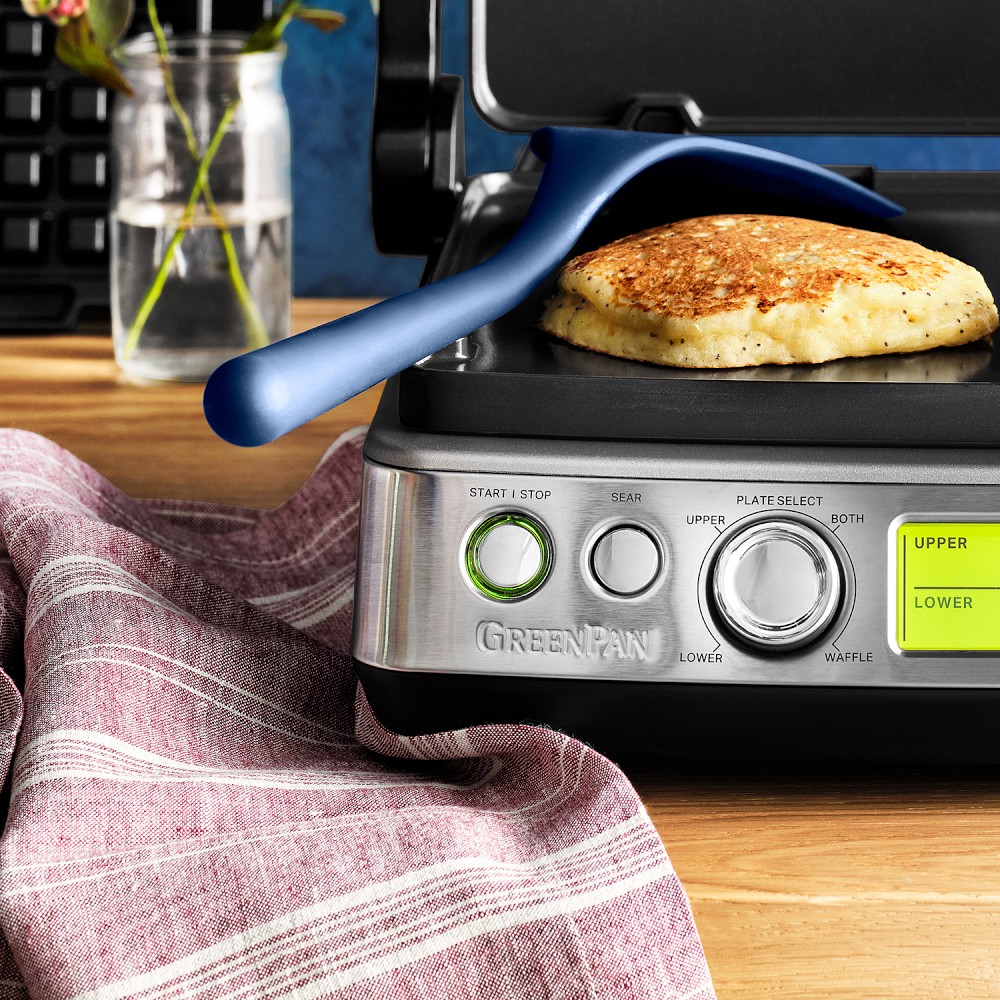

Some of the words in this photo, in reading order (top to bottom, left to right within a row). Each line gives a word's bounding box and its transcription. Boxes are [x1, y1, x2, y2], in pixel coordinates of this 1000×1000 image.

[469, 487, 508, 498] START
[520, 489, 553, 500] STOP
[611, 492, 643, 503] SEAR
[736, 495, 775, 506] PLATE
[776, 495, 824, 507] SELECT
[686, 515, 726, 526] UPPER
[831, 513, 865, 524] BOTH
[914, 536, 968, 549] UPPER
[914, 596, 973, 609] LOWER
[679, 652, 723, 664] LOWER
[824, 652, 874, 663] WAFFLE
